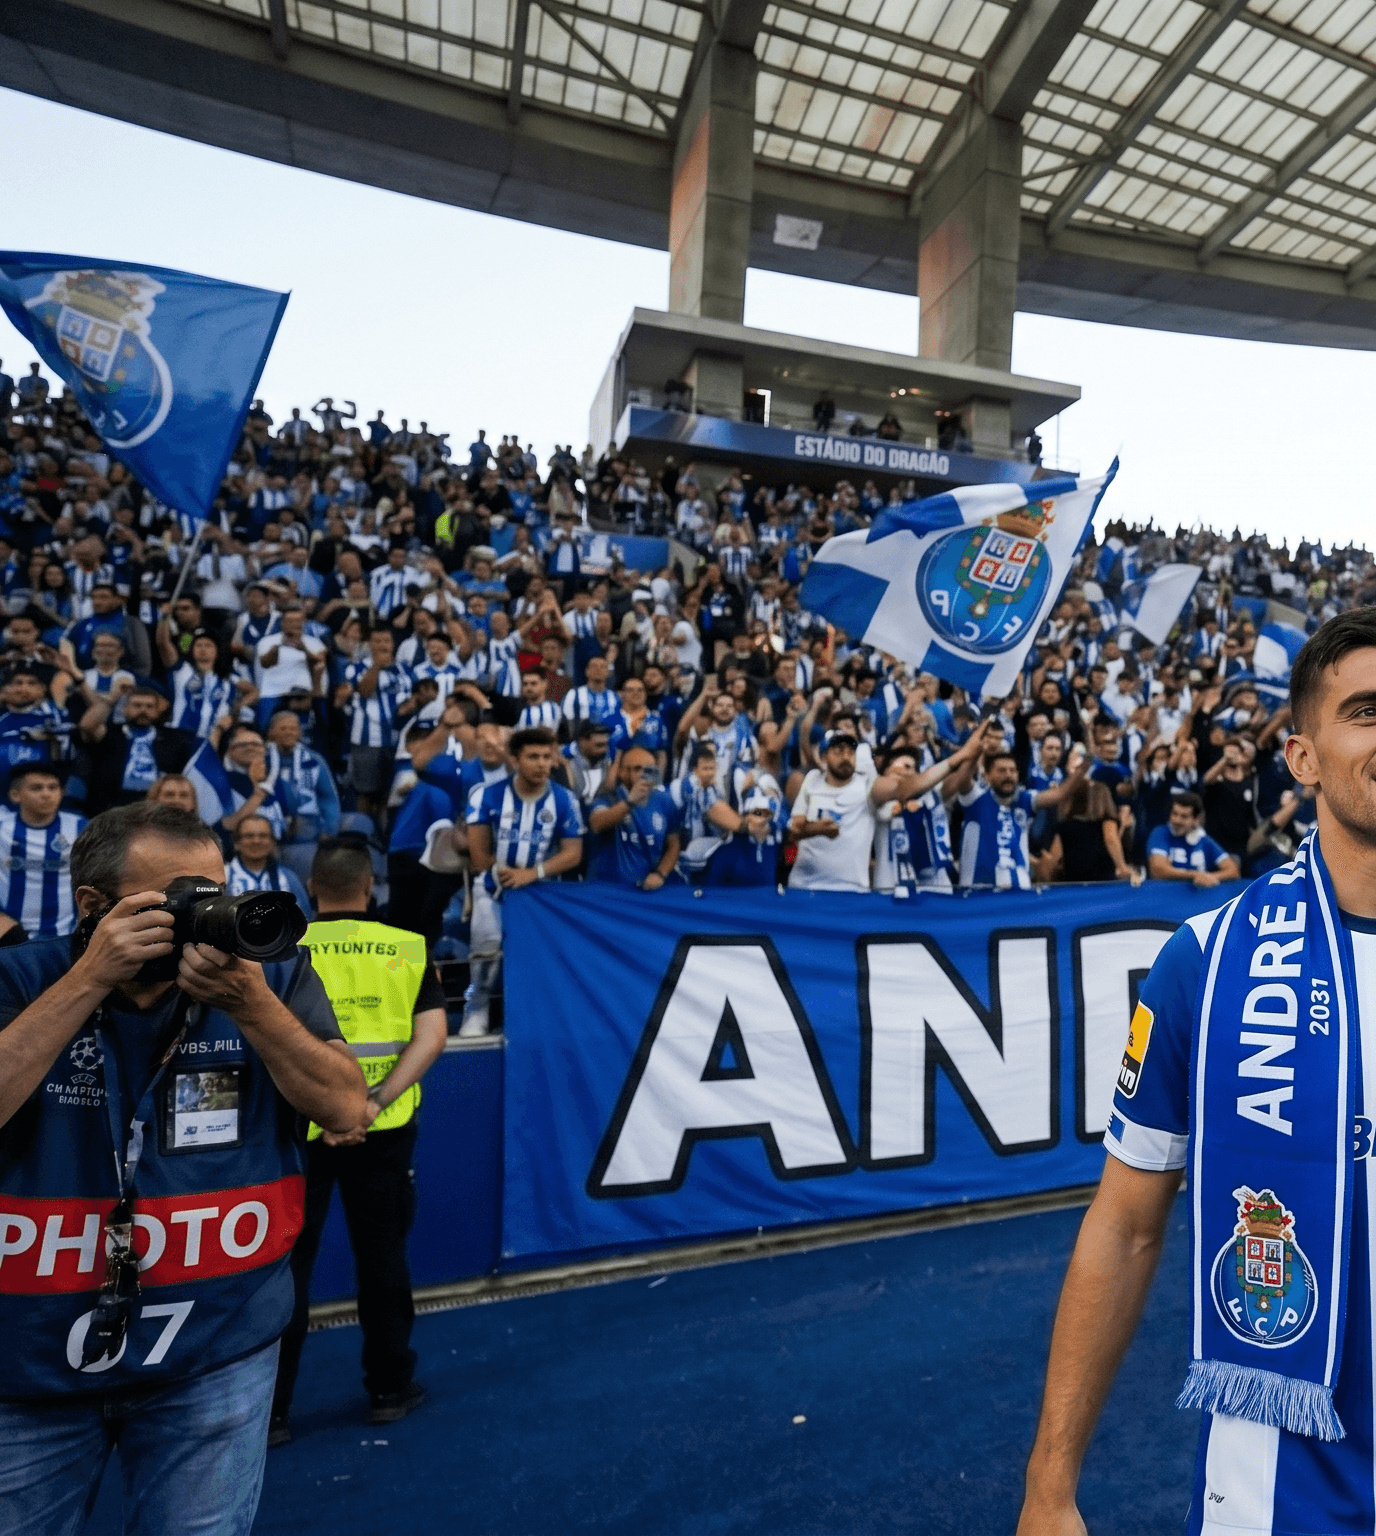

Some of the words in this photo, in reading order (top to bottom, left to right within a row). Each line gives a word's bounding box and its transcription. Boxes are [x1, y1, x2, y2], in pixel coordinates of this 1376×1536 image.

[794, 434, 861, 463] ESTÁDIO
[863, 444, 886, 467] DO
[1235, 900, 1308, 1138] ANDRÉ
[1309, 977, 1331, 1036] 2031
[594, 926, 1178, 1190] AN
[0, 1200, 270, 1278] PHOTO
[1227, 1297, 1299, 1336] FCP
